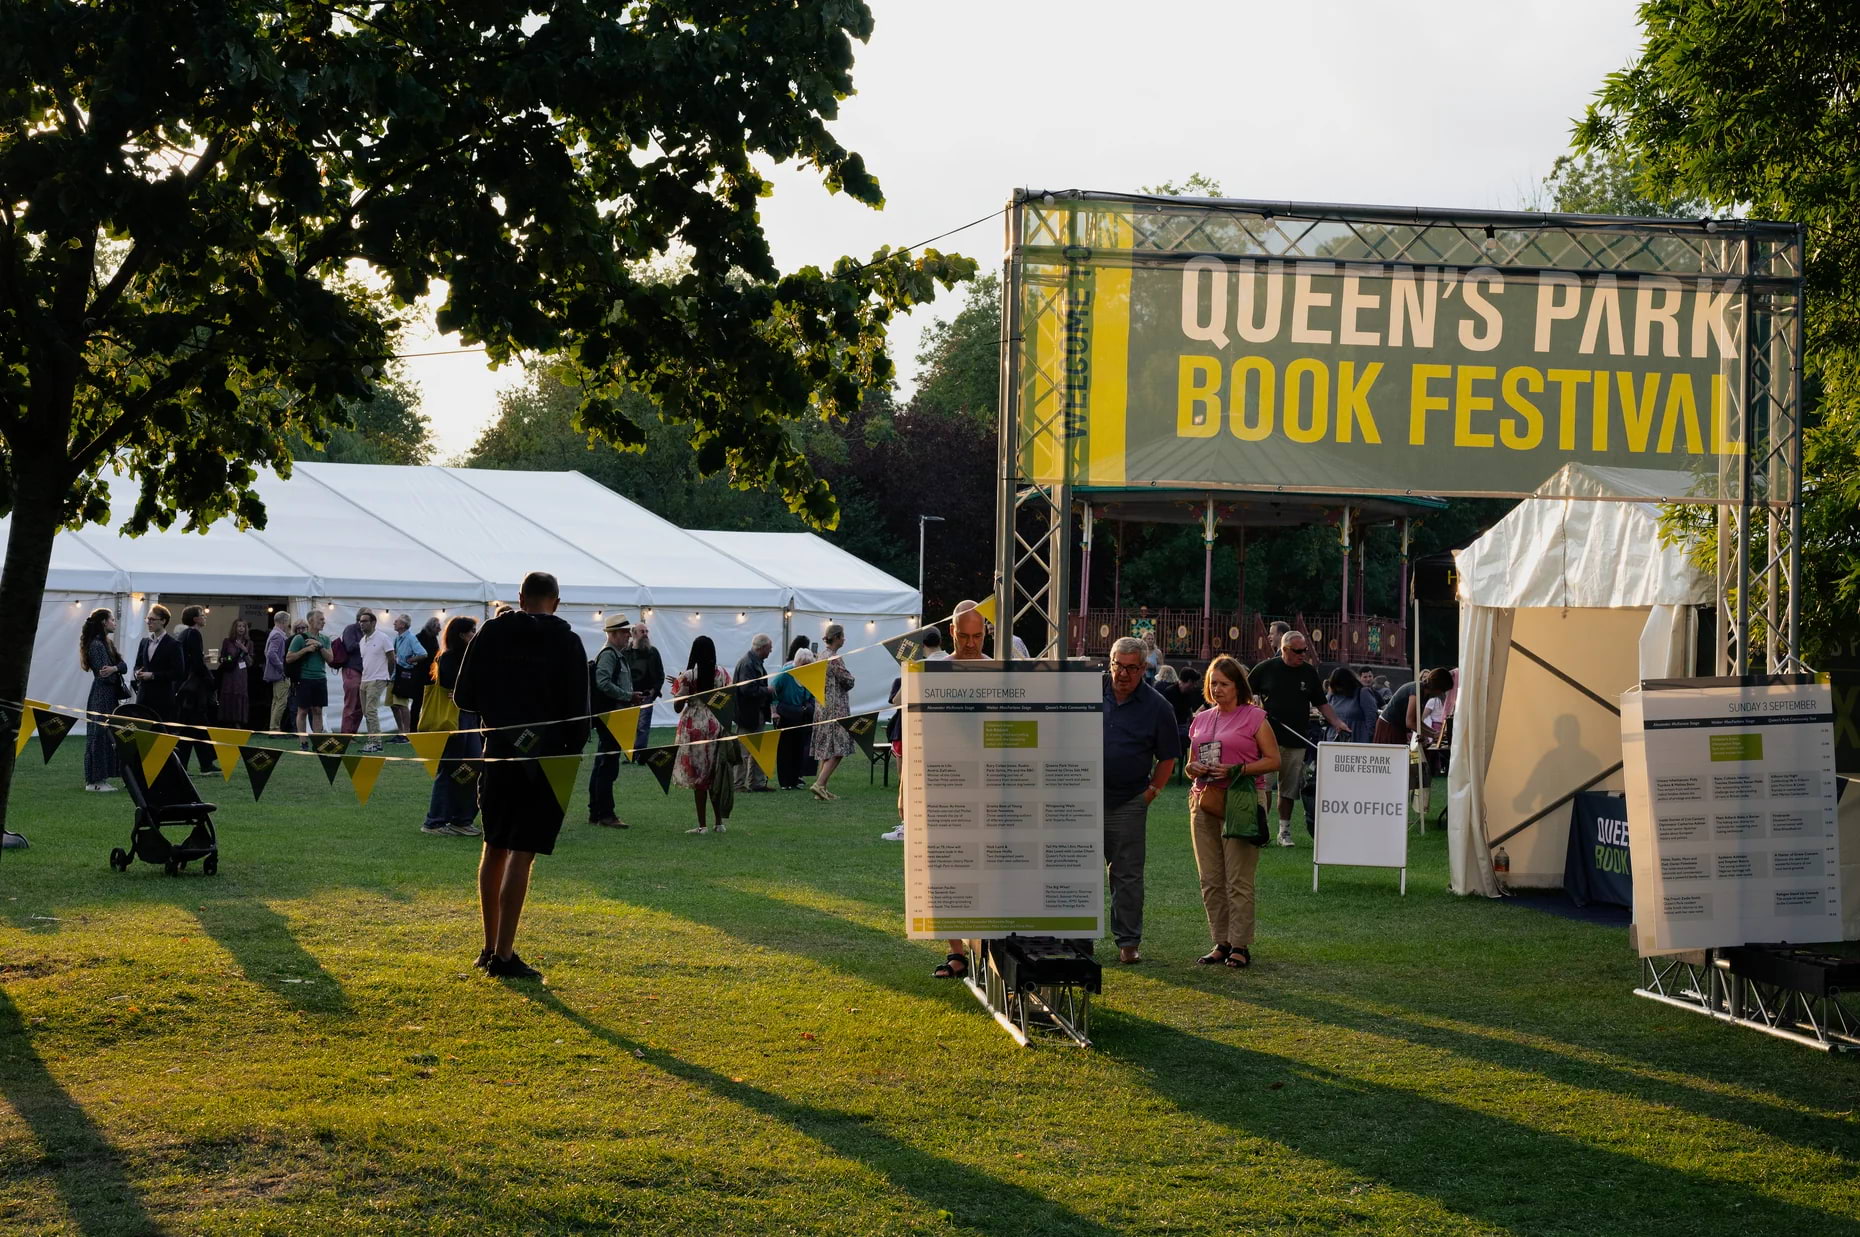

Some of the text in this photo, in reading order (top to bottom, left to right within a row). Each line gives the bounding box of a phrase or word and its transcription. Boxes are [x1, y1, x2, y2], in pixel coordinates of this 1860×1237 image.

[1181, 255, 1743, 359] QUEEN'S PARK
[1058, 244, 1092, 440] WELCOME TO
[1176, 354, 1748, 455] BOOK FESTIVAL
[924, 688, 1026, 698] SATURDAY 2 SEPTEMBER
[1728, 699, 1817, 712] SUNDAY 3 SEPTEMBER
[1334, 754, 1391, 765] QUEEN'S PARK
[1334, 764, 1391, 774] BOOK FESTIVAL
[1321, 799, 1403, 816] BOX OFFICE
[1597, 817, 1629, 846] QUEE
[1595, 845, 1629, 875] BOOK
